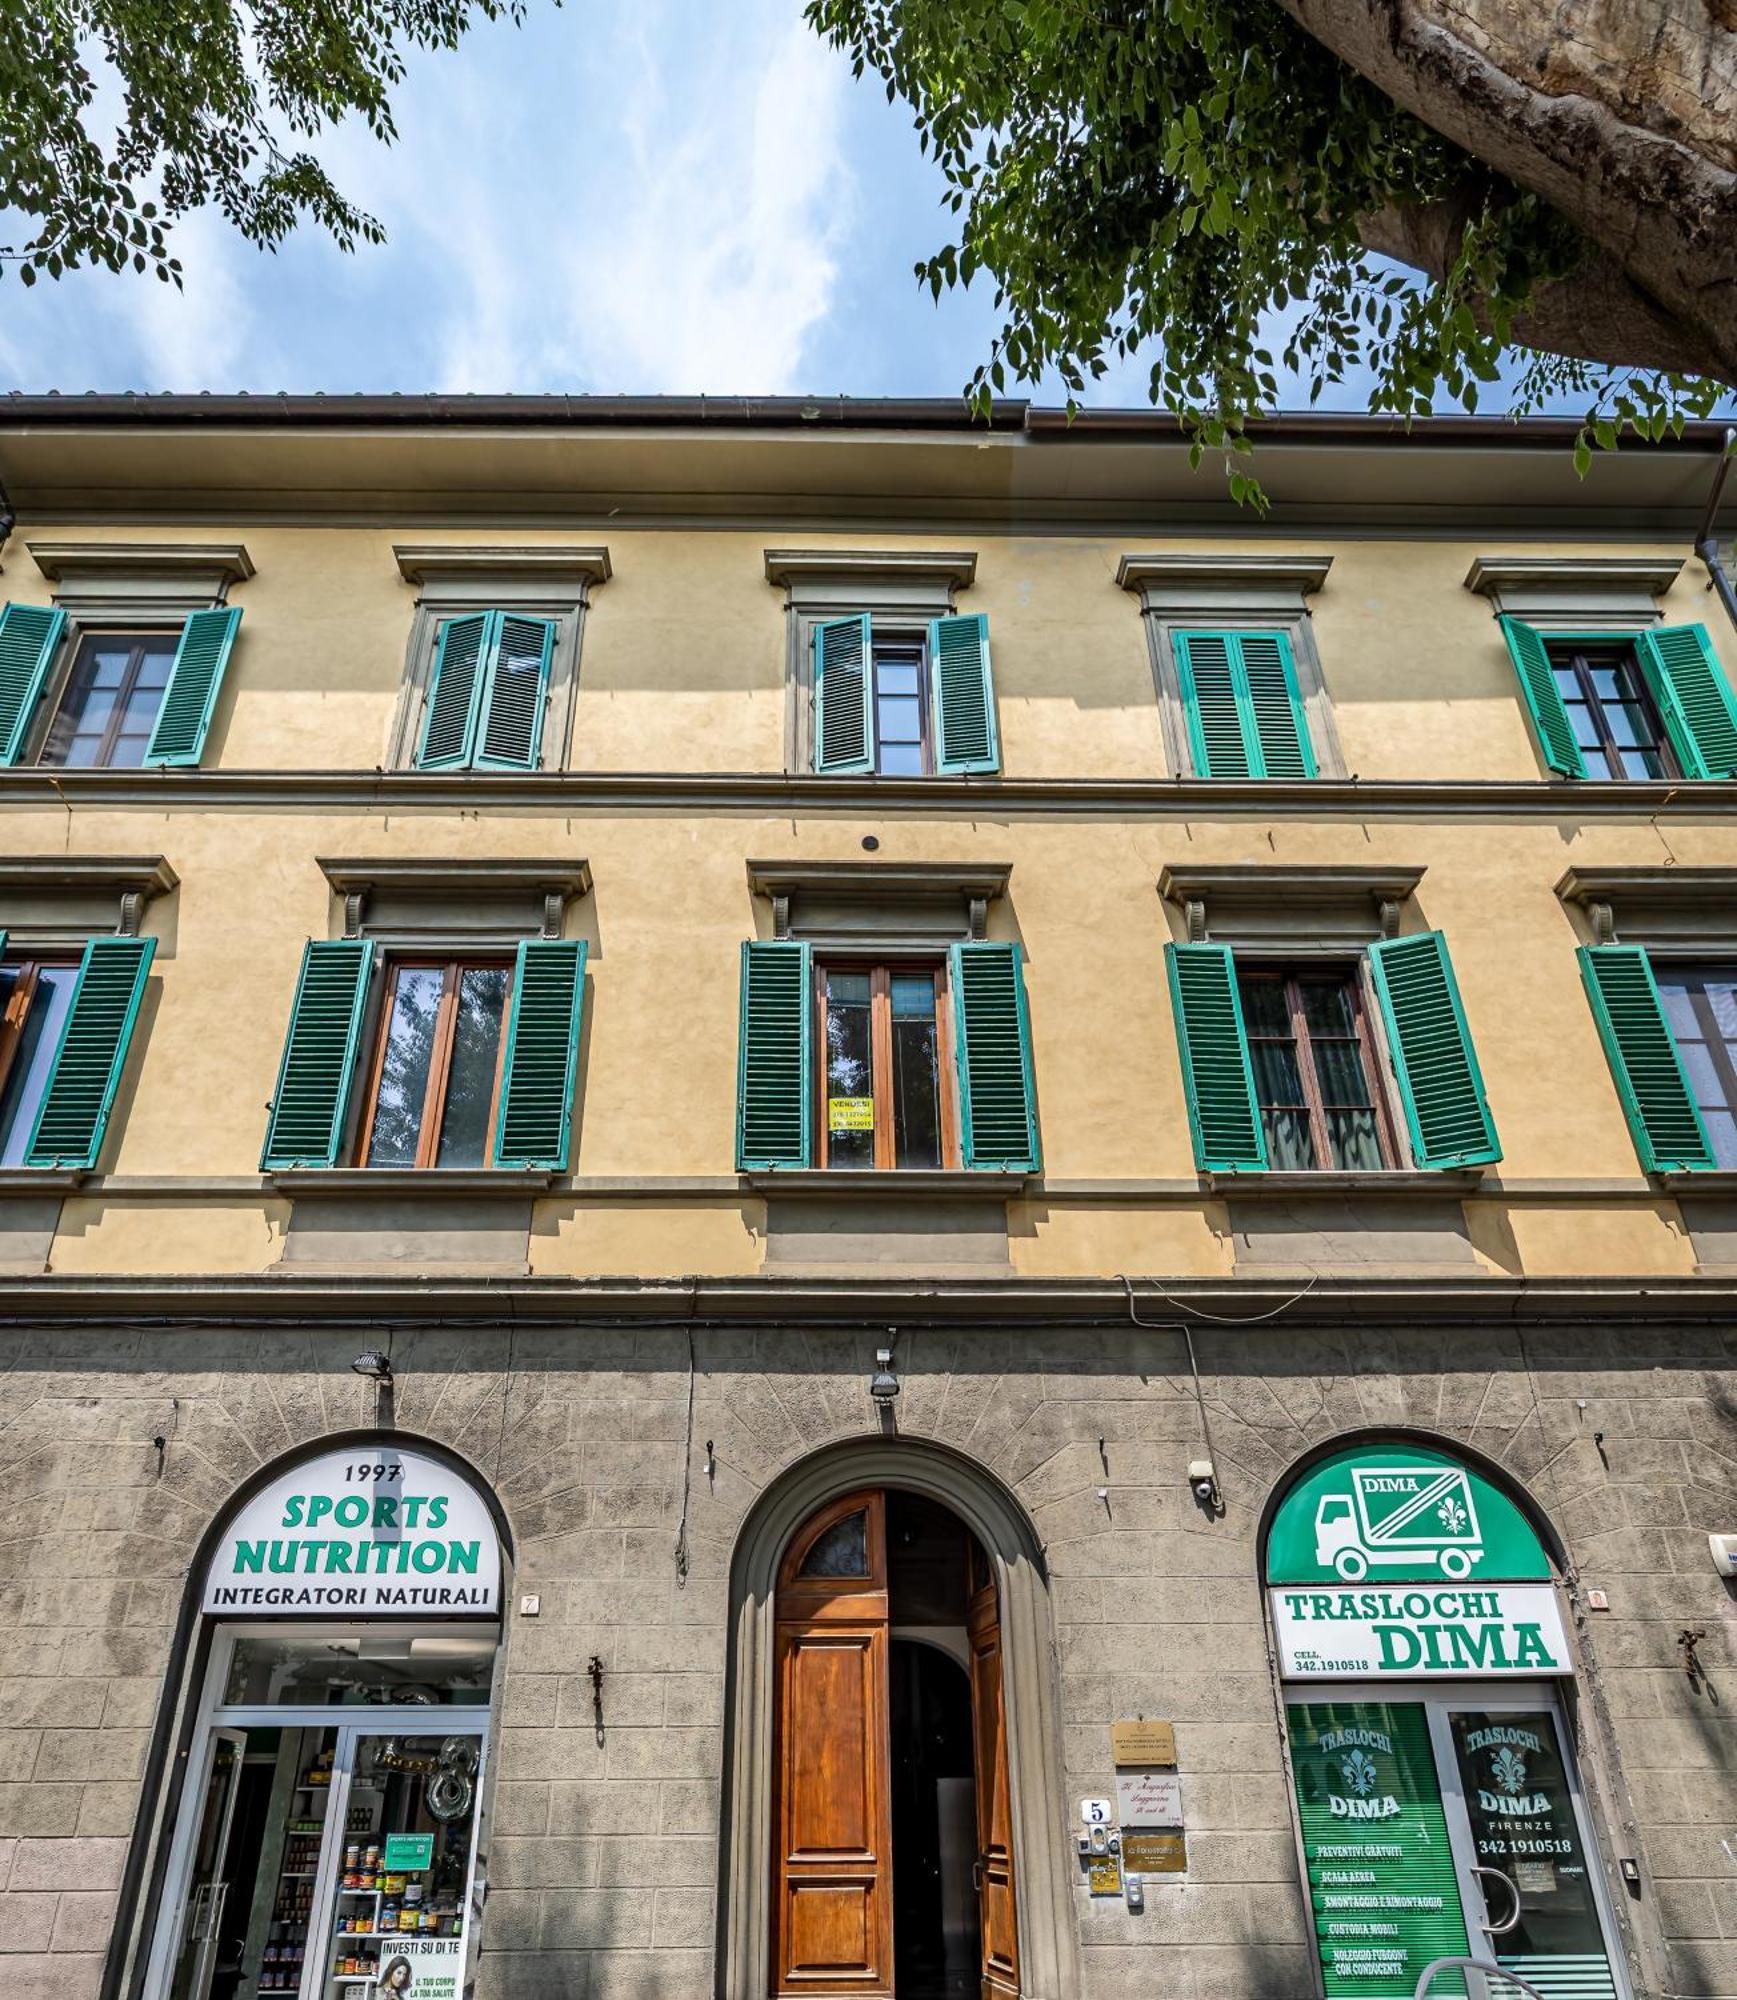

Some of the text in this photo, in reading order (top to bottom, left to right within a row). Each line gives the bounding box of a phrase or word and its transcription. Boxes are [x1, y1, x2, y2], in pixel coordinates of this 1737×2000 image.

[345, 1464, 402, 1482] 1997
[1362, 1478, 1421, 1493] DIMA
[282, 1495, 449, 1528] SPORTS
[233, 1541, 481, 1574] NUTRITION
[213, 1588, 490, 1604] INTEGRATORI NATURALI
[526, 1598, 536, 1610] 7
[1285, 1592, 1503, 1620] TRASLOCHI
[1372, 1623, 1558, 1670] DIMA
[1294, 1651, 1322, 1660] CELL.
[1296, 1660, 1369, 1672] 342.1910518
[1320, 1729, 1392, 1754] TRASLOCHI
[1467, 1726, 1541, 1753] TRASLOCHI
[1328, 1794, 1401, 1818] DIMA
[1478, 1789, 1552, 1815] DIMA
[1091, 1802, 1103, 1821] 5
[1489, 1822, 1553, 1830] FIRENZE
[1318, 1846, 1403, 1857] PREVENTIVI GRATUITI
[1479, 1840, 1572, 1853] 342 1910518
[1321, 1872, 1376, 1882] SCALA AEREA
[1324, 1896, 1378, 1908] SMONTAGGIO
[1329, 1923, 1369, 1934] CUSTODIA
[383, 1941, 460, 1954] INVESTI SU DI TE
[1333, 1949, 1371, 1961] NOLEGGIO
[1335, 1962, 1352, 1975] CON
[436, 1978, 455, 1986] CORPO
[410, 1990, 418, 1998] LA
[432, 1990, 455, 1998] SALUTE
